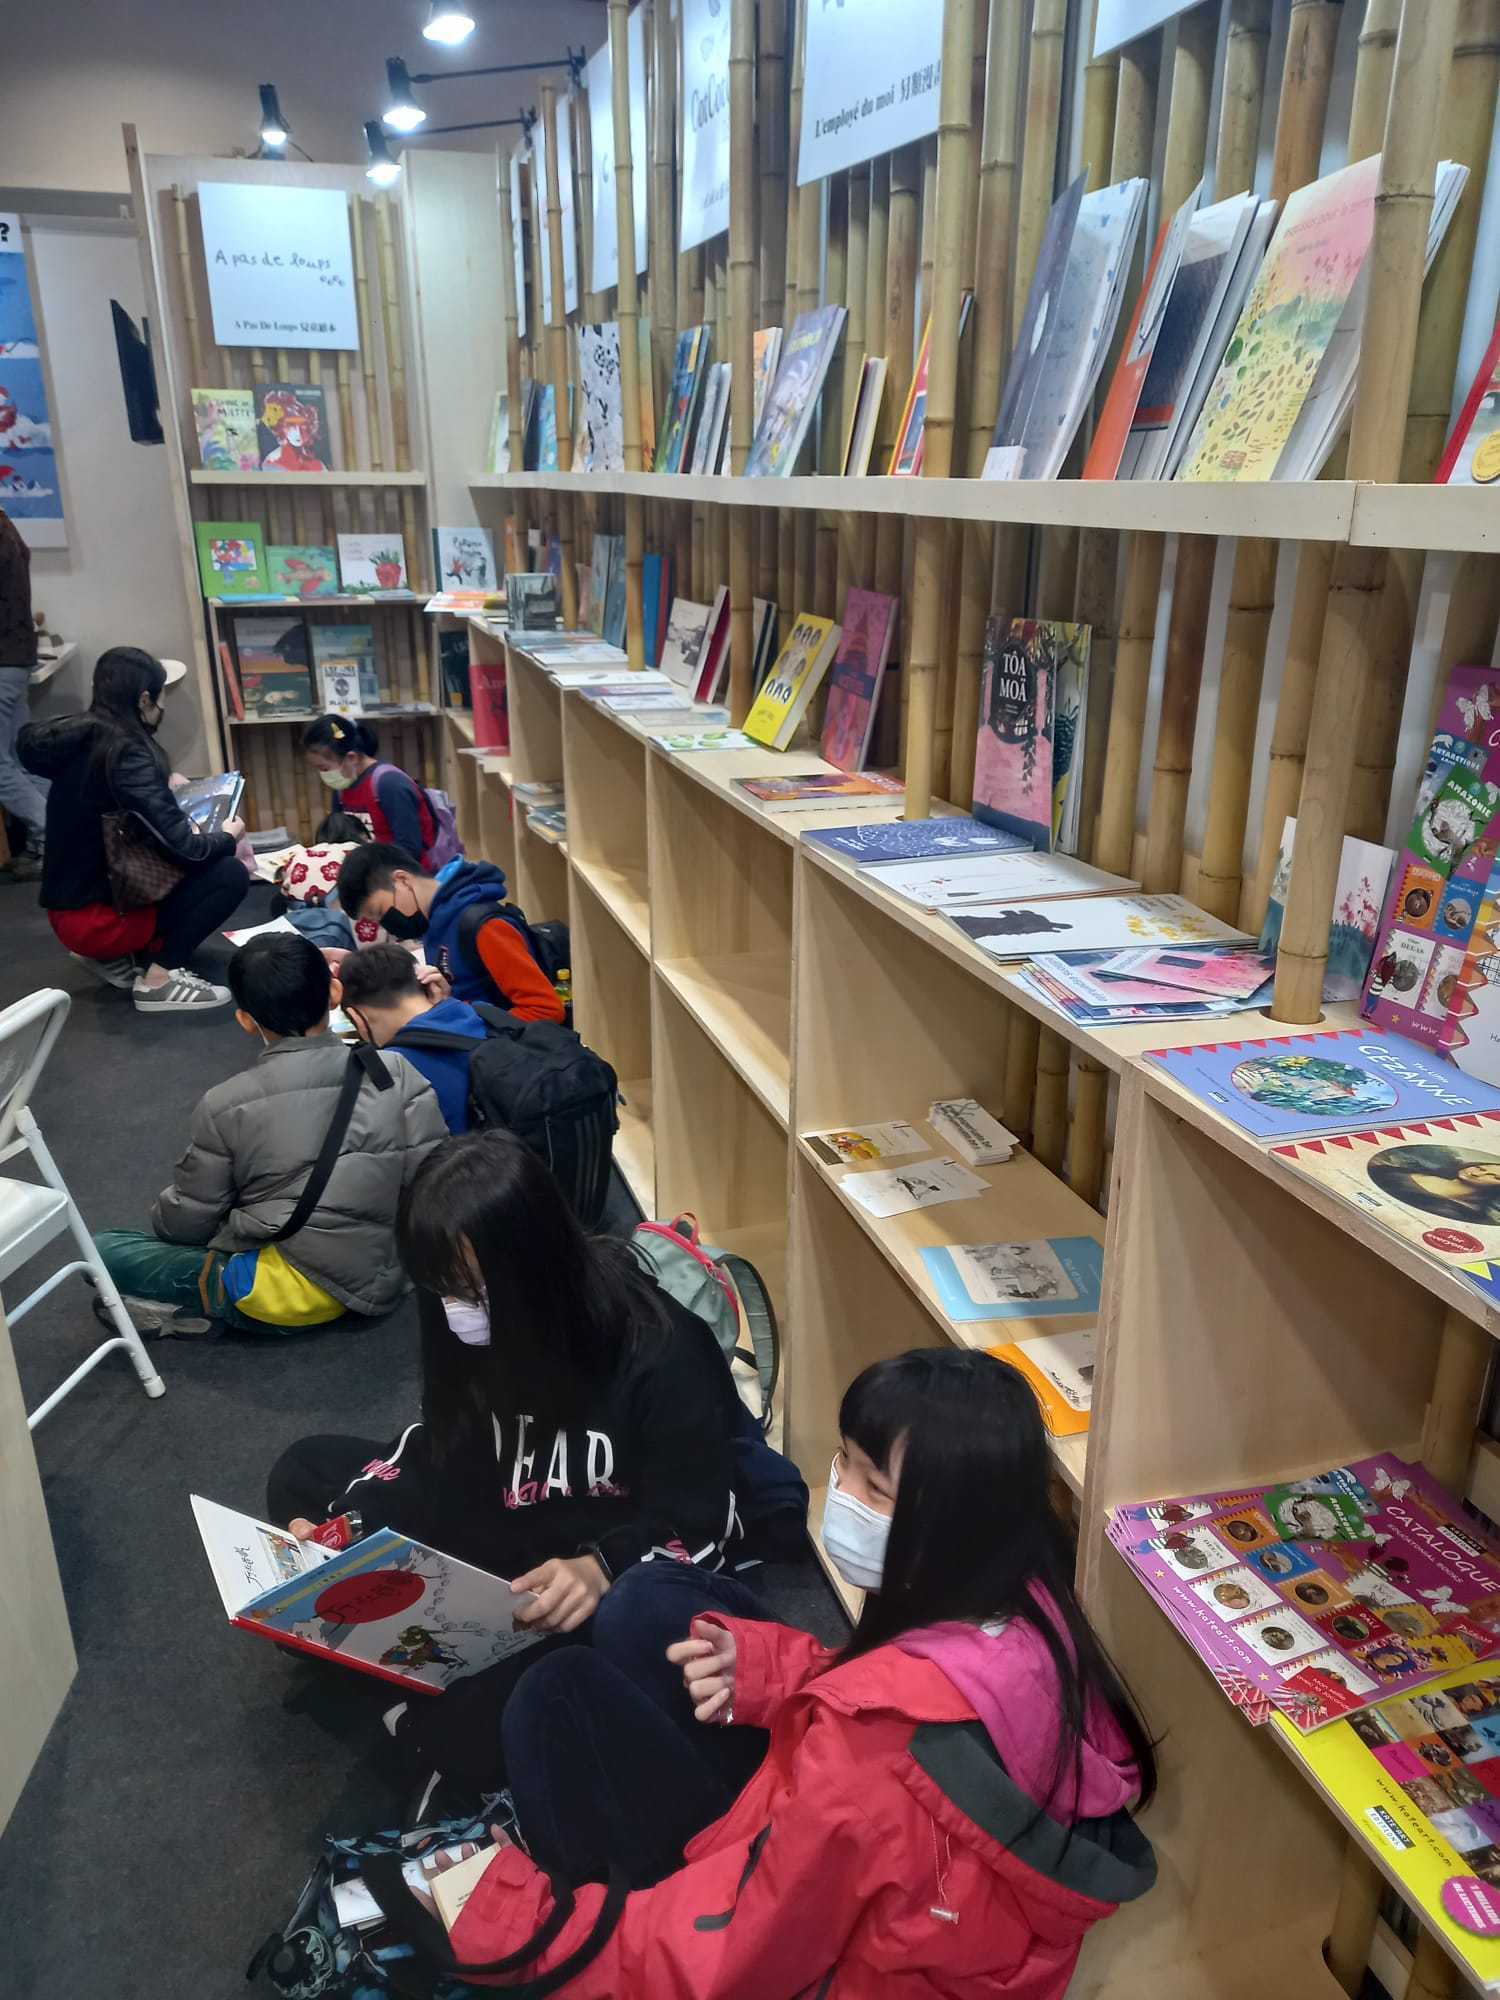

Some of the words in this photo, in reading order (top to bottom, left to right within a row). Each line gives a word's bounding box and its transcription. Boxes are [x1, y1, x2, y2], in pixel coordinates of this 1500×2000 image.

[815, 99, 859, 138] L'employé
[861, 97, 874, 118] du
[876, 84, 895, 112] moi
[215, 248, 228, 266] A
[233, 253, 258, 267] pas
[262, 251, 284, 267] de
[290, 252, 331, 271] loups
[243, 320, 258, 330] Pas
[261, 321, 272, 330] De
[274, 321, 298, 333] Loups
[1003, 650, 1027, 676] TÔA
[1447, 780, 1493, 818] AMAZONIE
[1358, 1045, 1473, 1106] CÉZANNE
[1386, 1506, 1500, 1593] CATALOGUE
[1173, 1585, 1253, 1665] www.kateart.com
[1376, 1777, 1452, 1867] www.kateart.com
